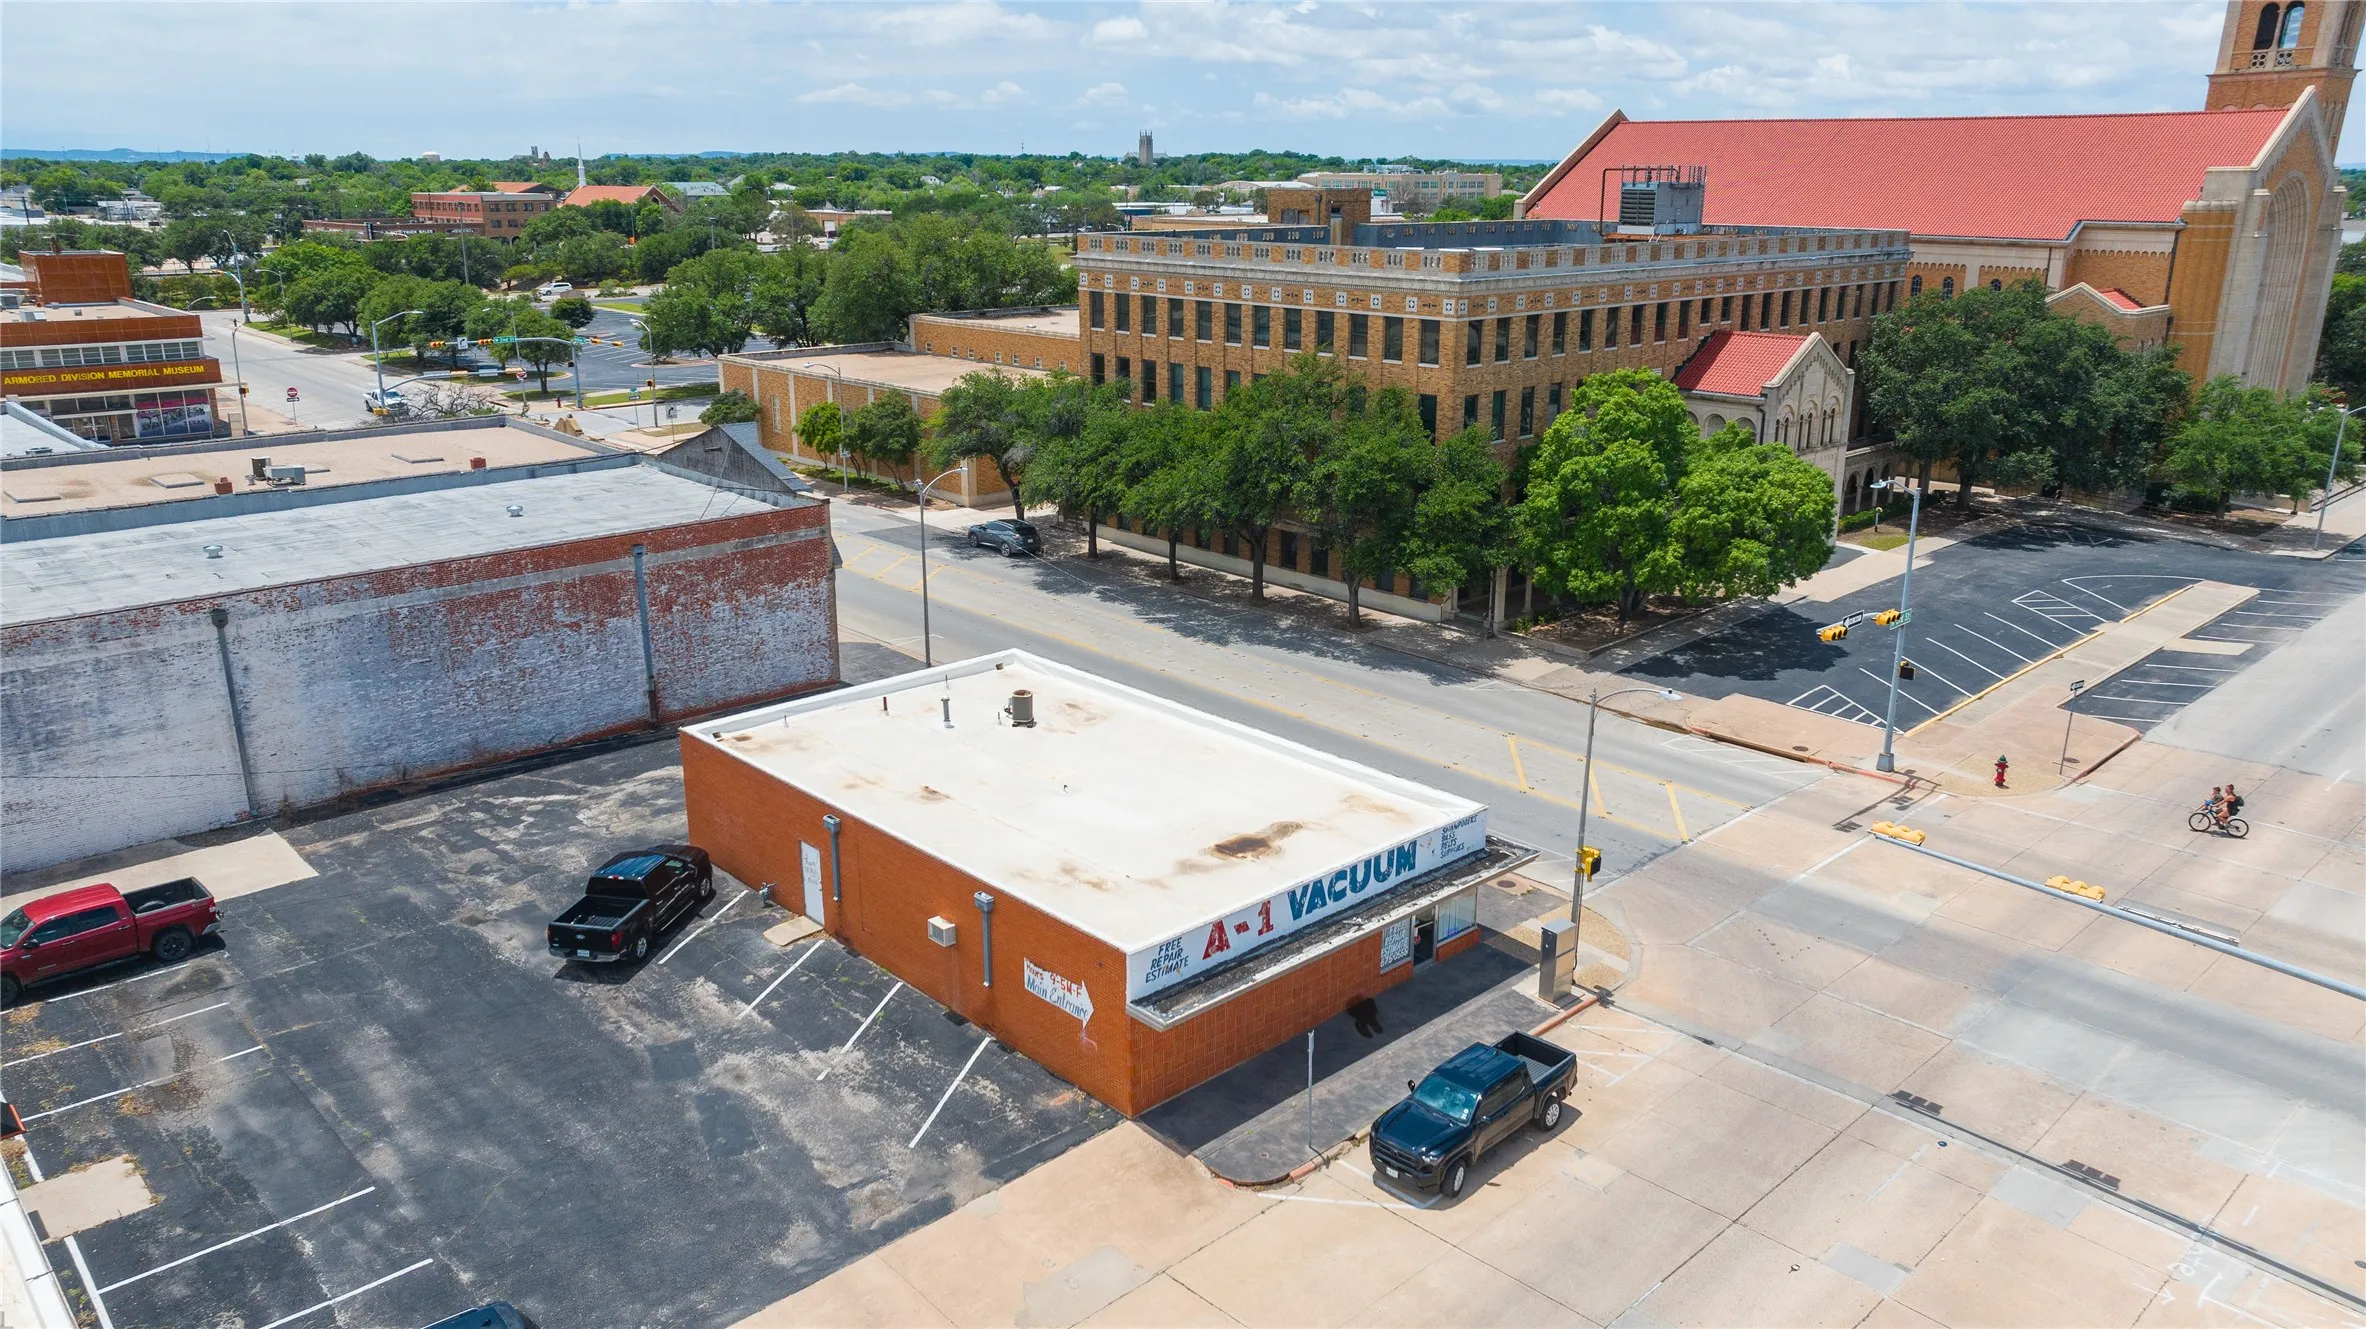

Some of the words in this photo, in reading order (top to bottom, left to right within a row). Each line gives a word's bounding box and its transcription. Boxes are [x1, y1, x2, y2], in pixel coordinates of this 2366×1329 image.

[4, 374, 56, 385] ARMORED
[61, 371, 105, 382] DIVISION
[108, 368, 160, 380] MEMORIAL
[163, 365, 205, 376] MUSEUM
[1287, 840, 1418, 921] VACUUM
[1150, 948, 1184, 970] REPAIR
[1158, 937, 1182, 956] FREE
[1145, 955, 1189, 983] ESTIMATE
[1026, 974, 1048, 999] Main
[1049, 987, 1089, 1018] Entrance
